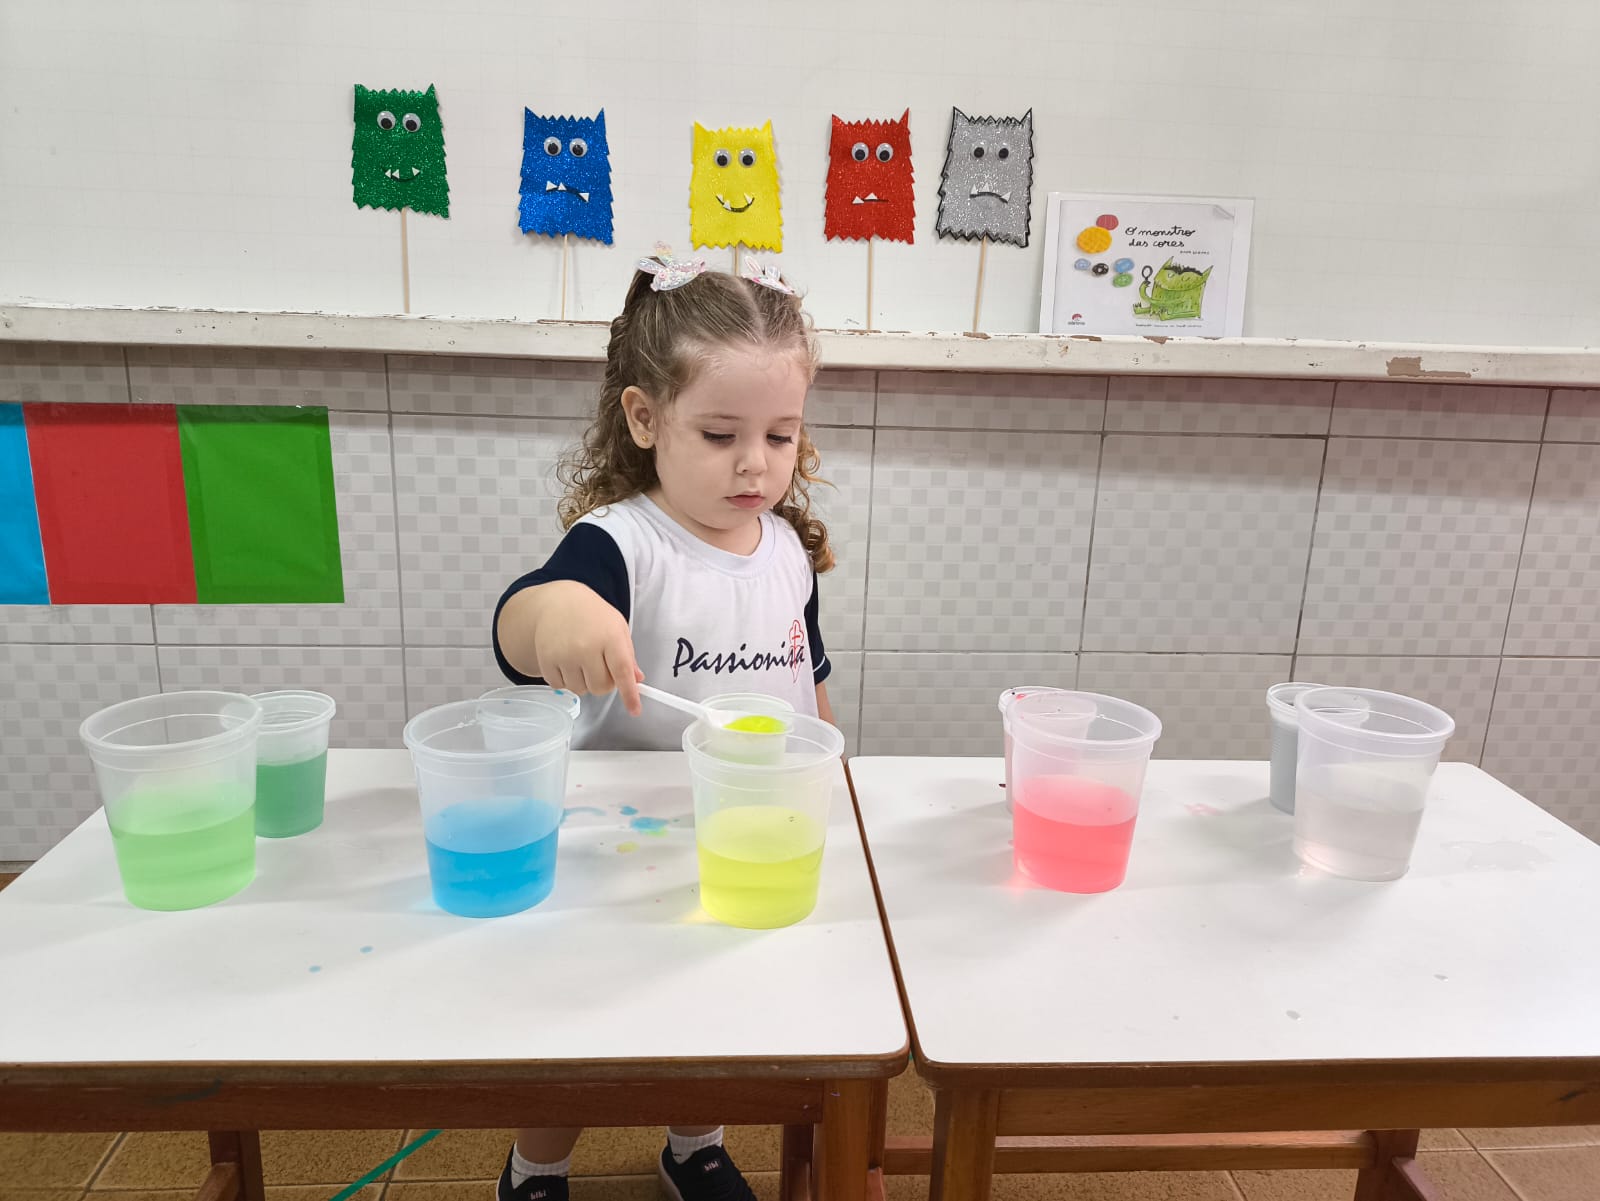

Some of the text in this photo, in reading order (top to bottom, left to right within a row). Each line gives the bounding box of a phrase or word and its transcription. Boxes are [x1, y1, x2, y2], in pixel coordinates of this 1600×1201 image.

[1125, 225, 1196, 237] O monstro
[1128, 238, 1185, 248] das cores
